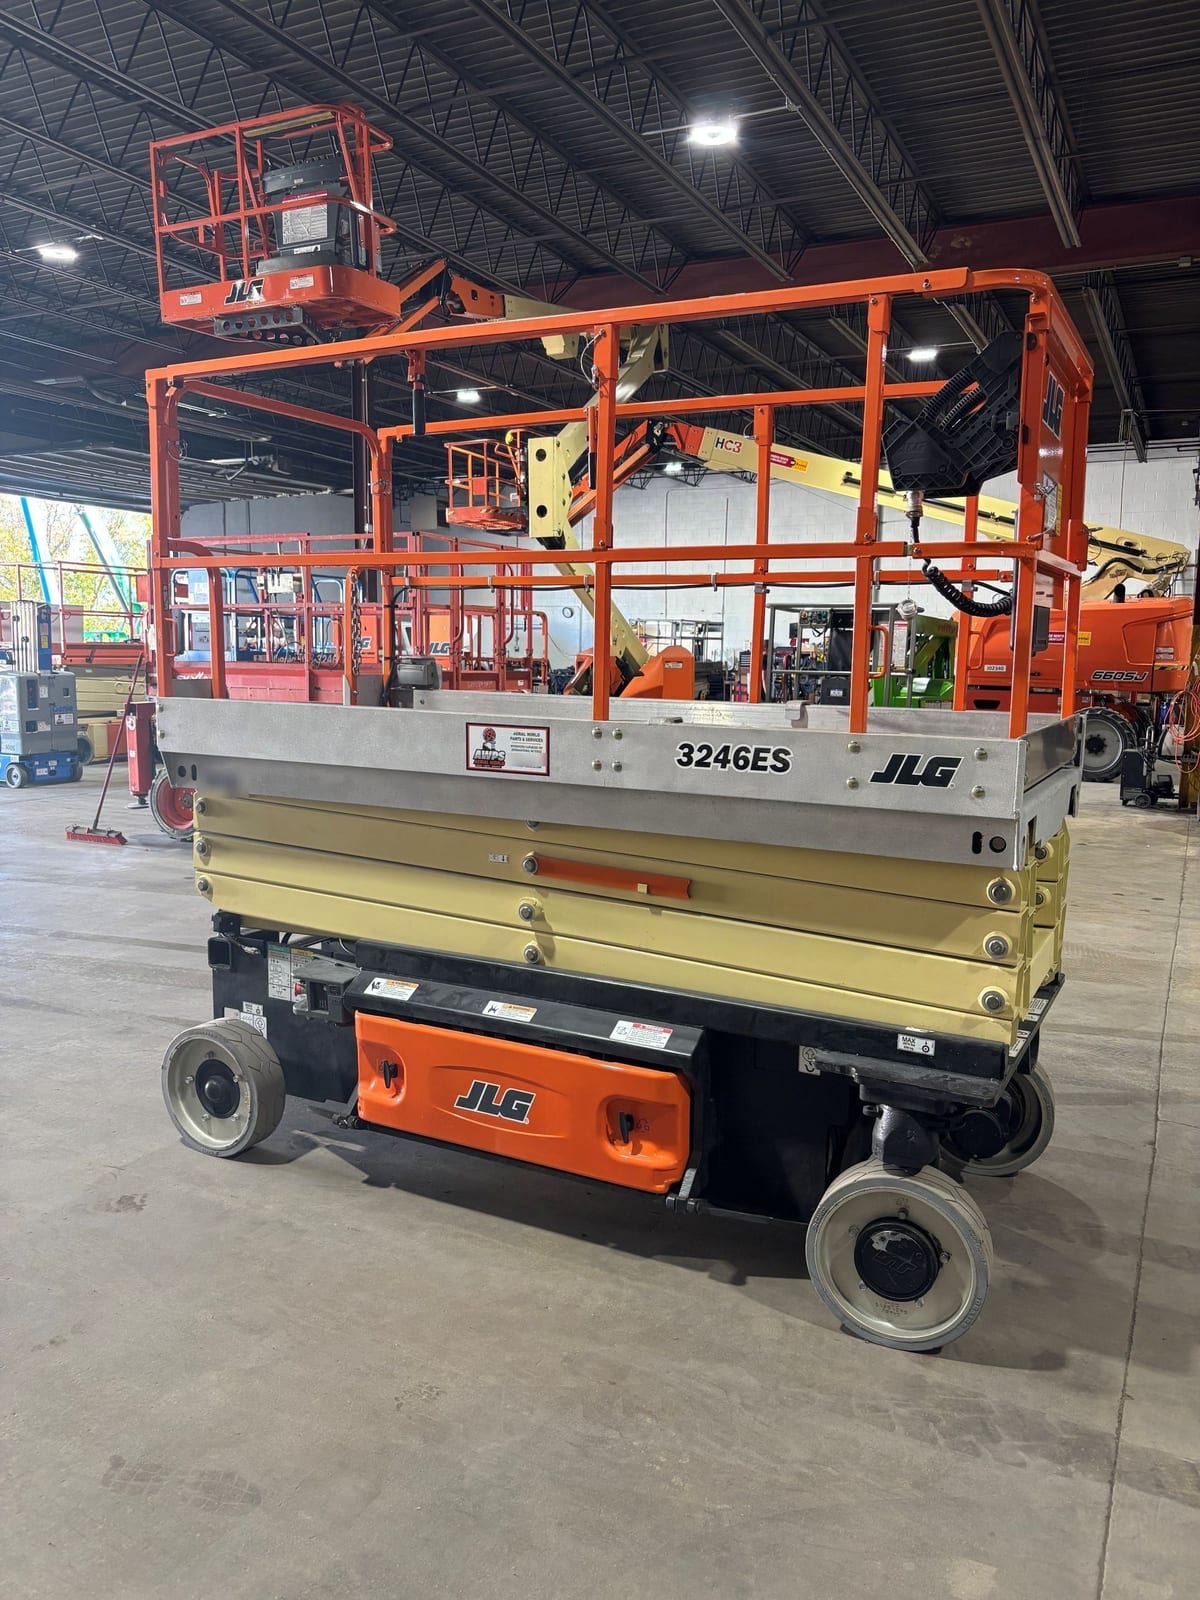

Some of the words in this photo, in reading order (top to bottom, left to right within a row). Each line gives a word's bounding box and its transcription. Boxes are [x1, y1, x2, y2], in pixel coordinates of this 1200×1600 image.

[1042, 371, 1065, 441] JLG
[715, 437, 742, 454] HC3
[1091, 671, 1149, 682] 660SJ
[473, 749, 506, 761] AWPS
[675, 742, 792, 774] 3246ES
[868, 752, 965, 790] JLG
[453, 1079, 536, 1125] JLG
